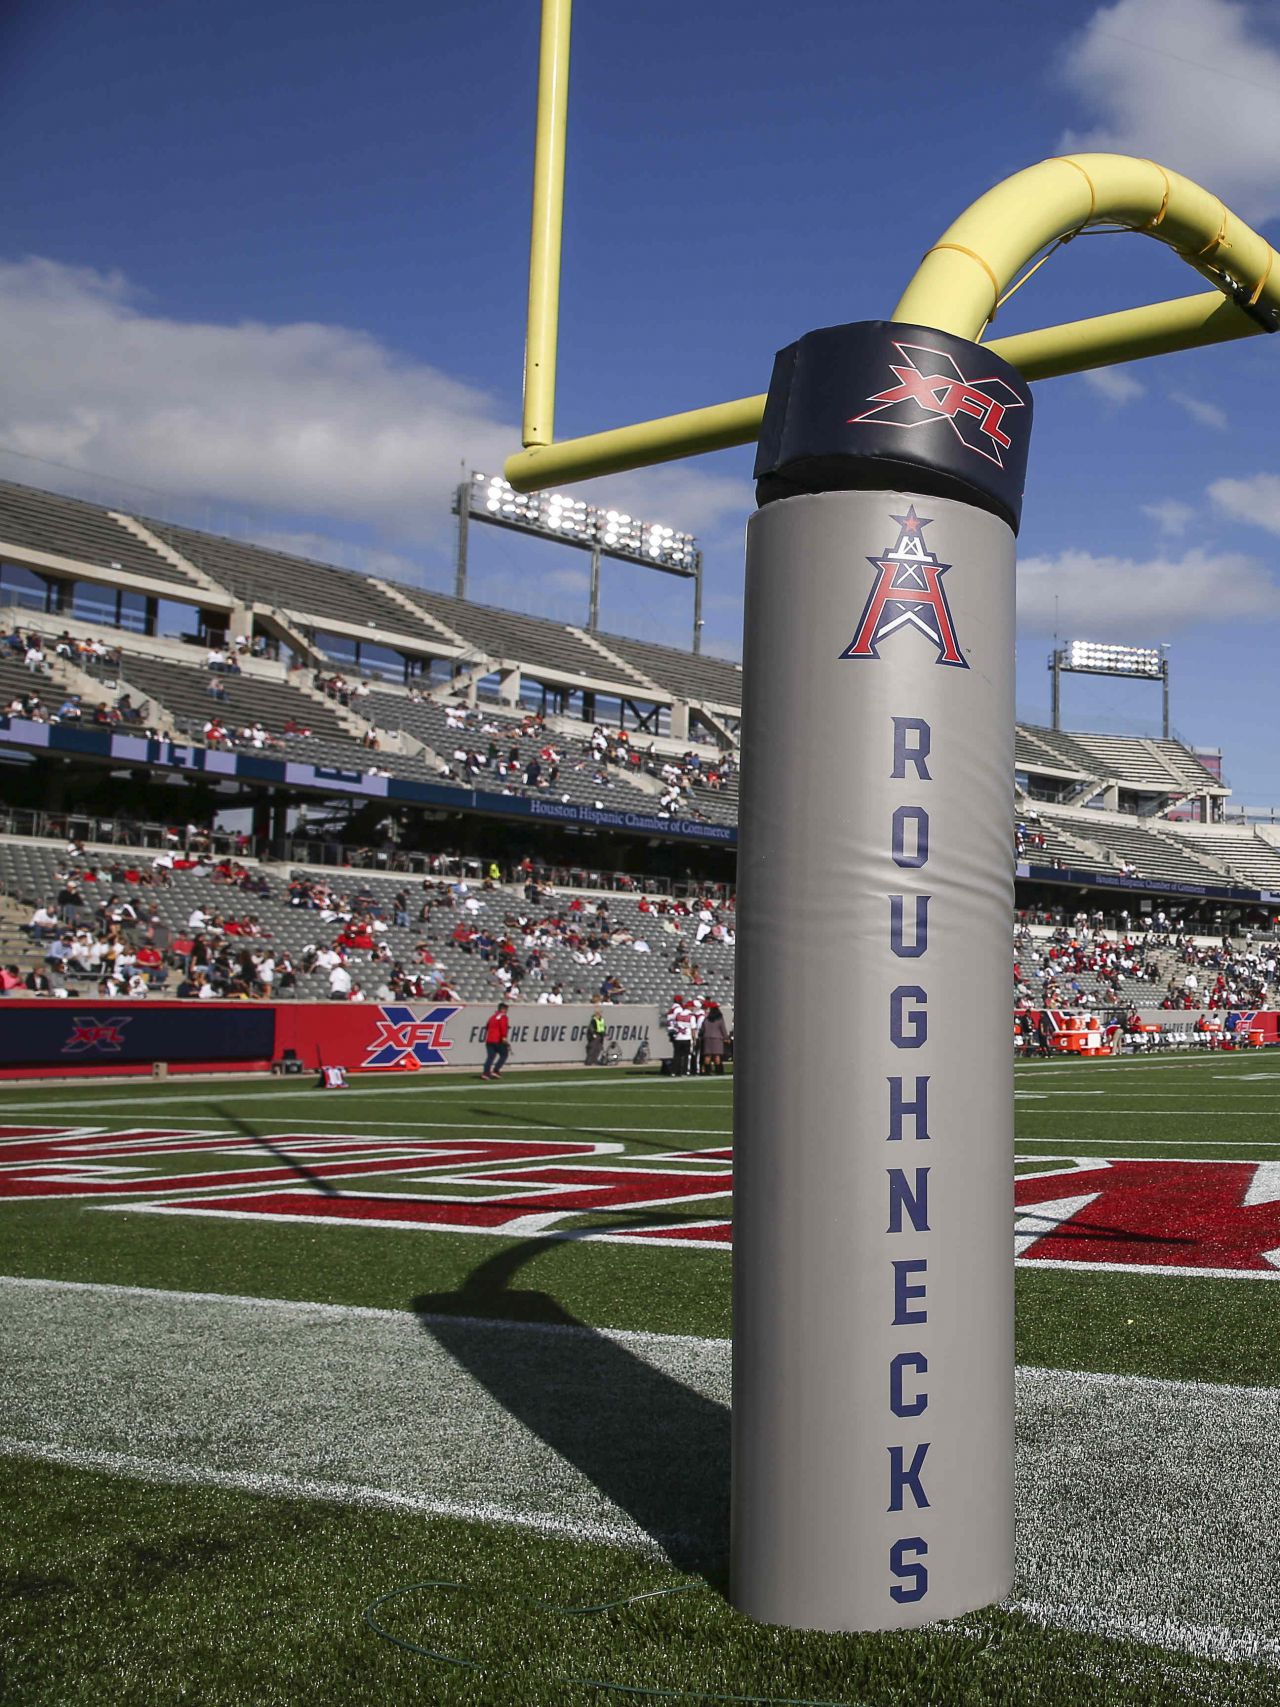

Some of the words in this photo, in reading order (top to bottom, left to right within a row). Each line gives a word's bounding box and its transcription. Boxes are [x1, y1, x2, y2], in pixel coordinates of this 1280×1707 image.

[866, 364, 1012, 449] XFL
[530, 800, 577, 818] Houston
[578, 806, 624, 825] Hispanic
[625, 812, 670, 829] Chamber
[671, 818, 681, 831] of
[682, 820, 731, 839] Commerce
[469, 1026, 488, 1043] FO
[533, 1026, 567, 1042] LOVE
[607, 1025, 650, 1041] OTBALL
[886, 715, 933, 1605] ROUGHNECKS
